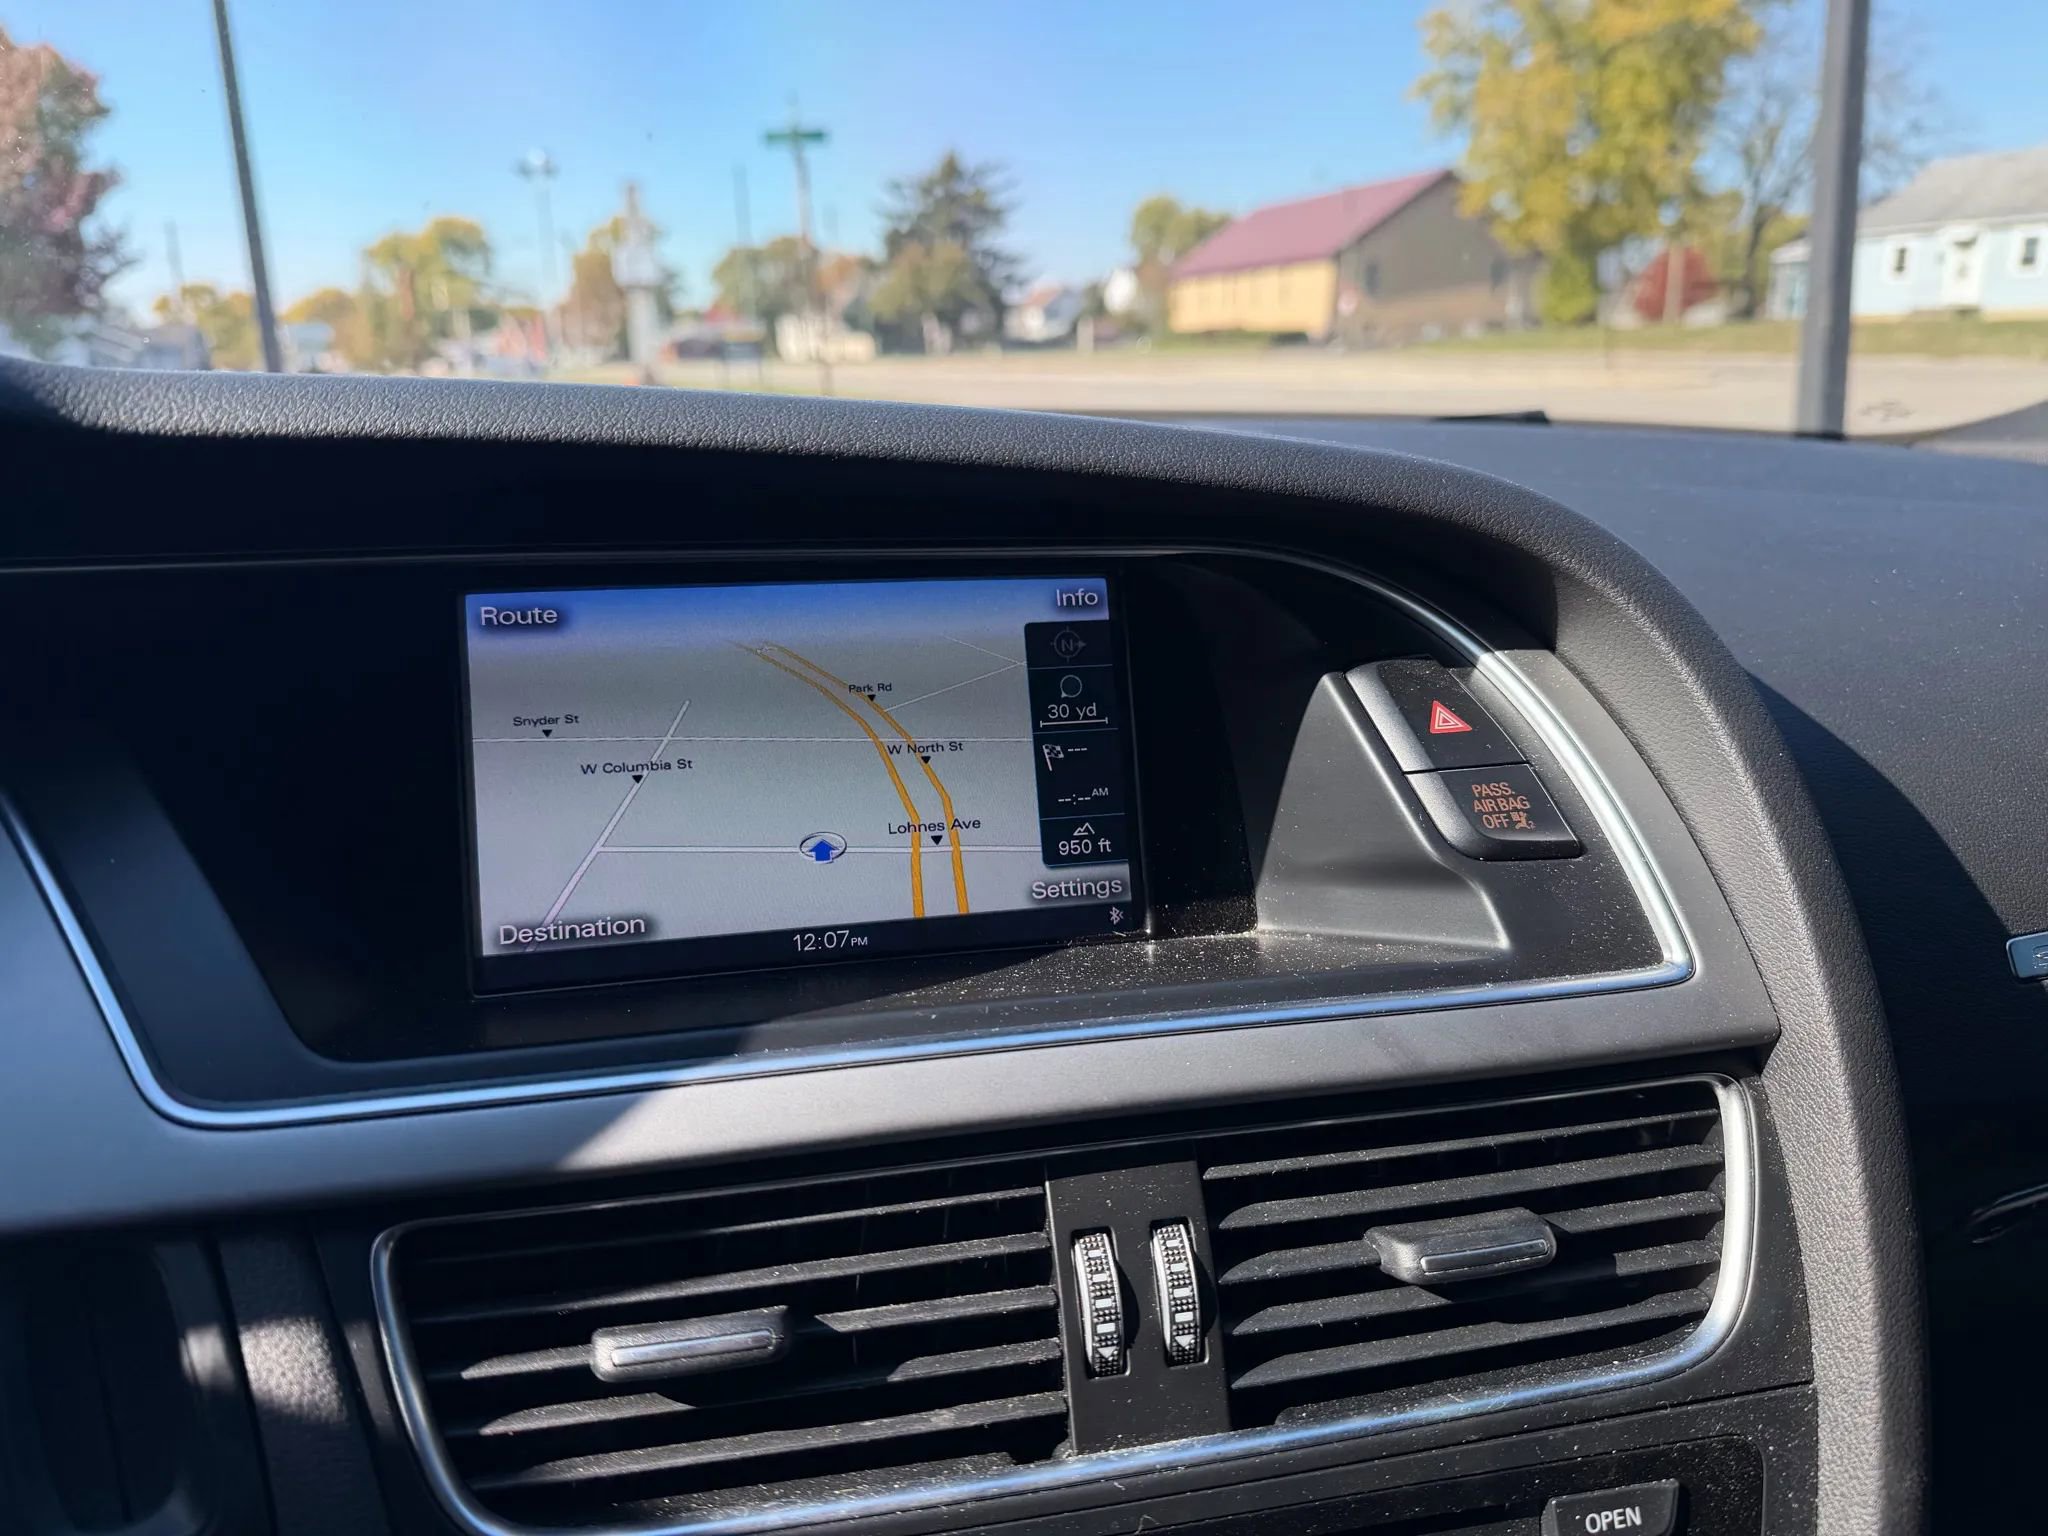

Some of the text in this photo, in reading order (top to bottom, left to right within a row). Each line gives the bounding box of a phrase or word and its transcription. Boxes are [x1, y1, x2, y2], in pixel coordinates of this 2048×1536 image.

[1056, 588, 1098, 607] Info
[480, 605, 558, 626] Route
[848, 682, 892, 694] Park Rd
[1047, 702, 1097, 721] 30 yd
[513, 714, 580, 728] Snyder St
[886, 741, 964, 755] W North St
[580, 758, 694, 775] W Columbia St
[1471, 782, 1516, 798] PASS.
[888, 818, 981, 835] Lohnes Ave
[1482, 813, 1510, 829] OFF
[1058, 837, 1112, 856] 950 ft
[1031, 878, 1123, 900] Settings
[499, 915, 646, 946] Destination
[1585, 1506, 1642, 1534] OPEN
